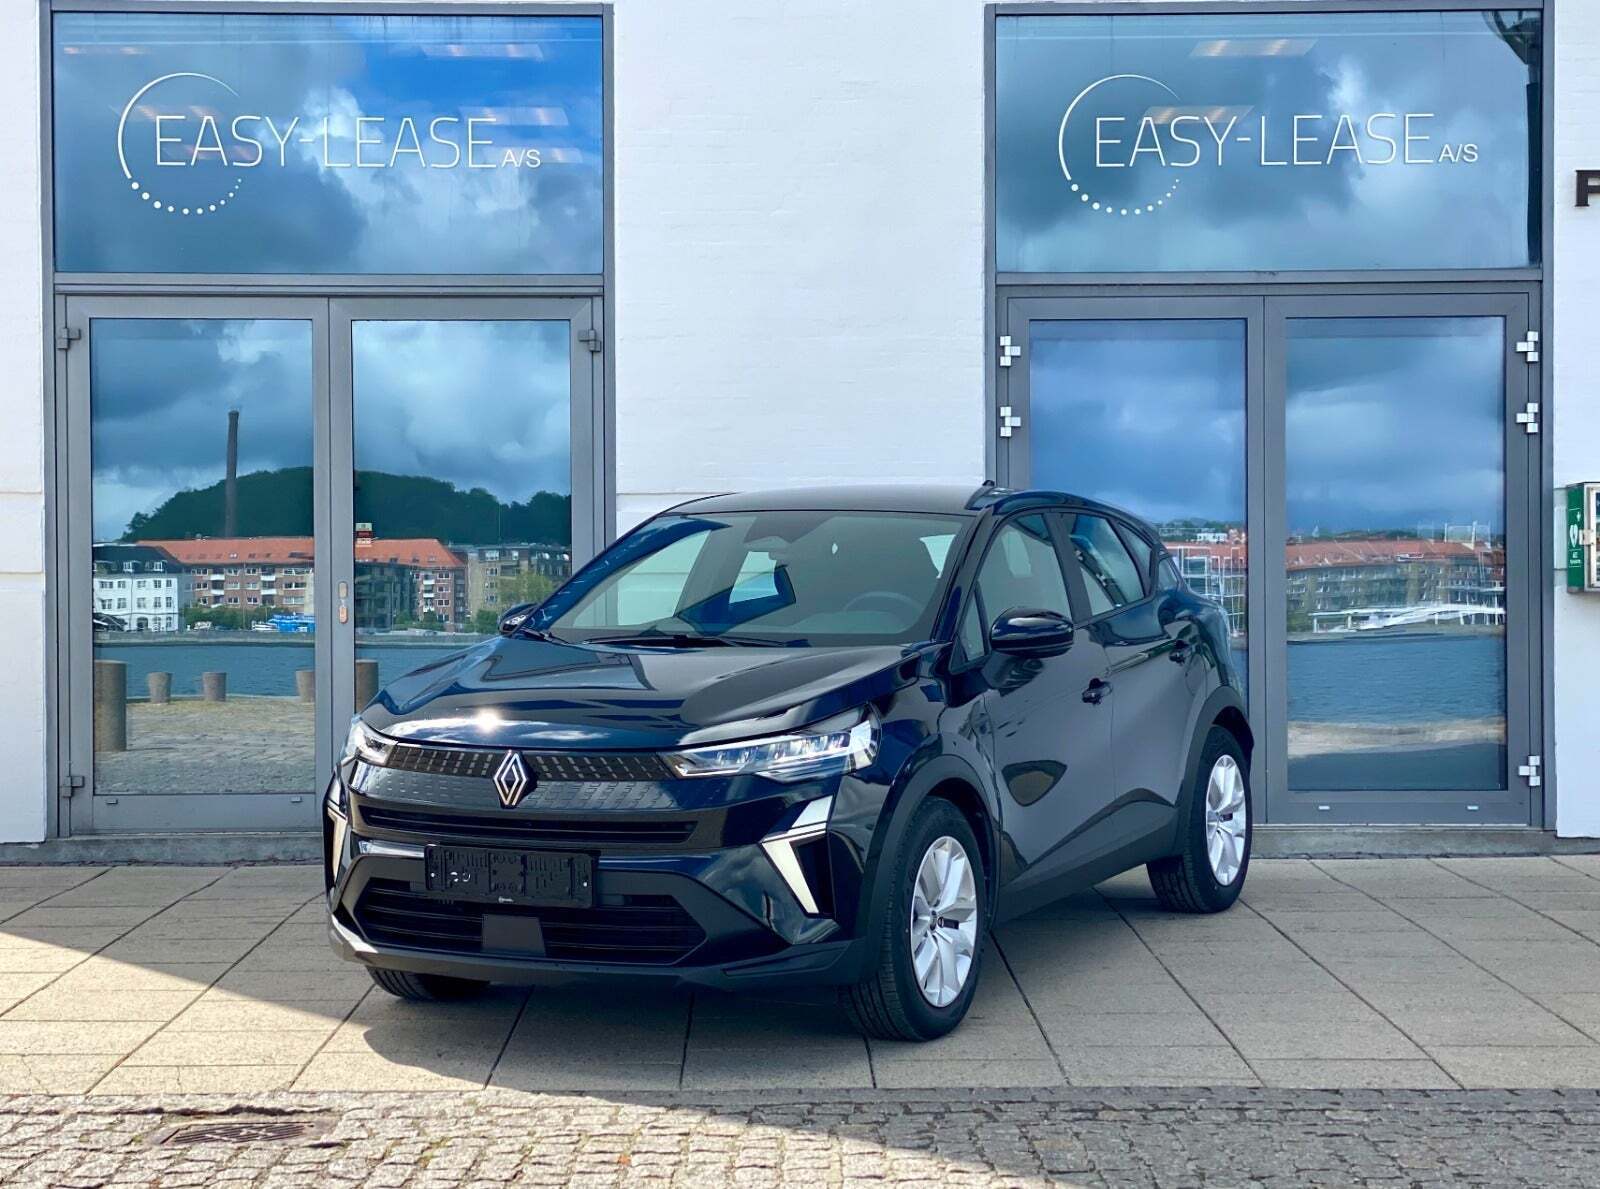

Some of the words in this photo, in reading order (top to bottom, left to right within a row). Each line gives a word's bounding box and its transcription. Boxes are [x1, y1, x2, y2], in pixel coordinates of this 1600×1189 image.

[155, 115, 497, 168] EASY-LEASE
[501, 149, 541, 168] A/S
[1095, 113, 1435, 167] EASY-LEASE
[1438, 143, 1479, 163] A/S
